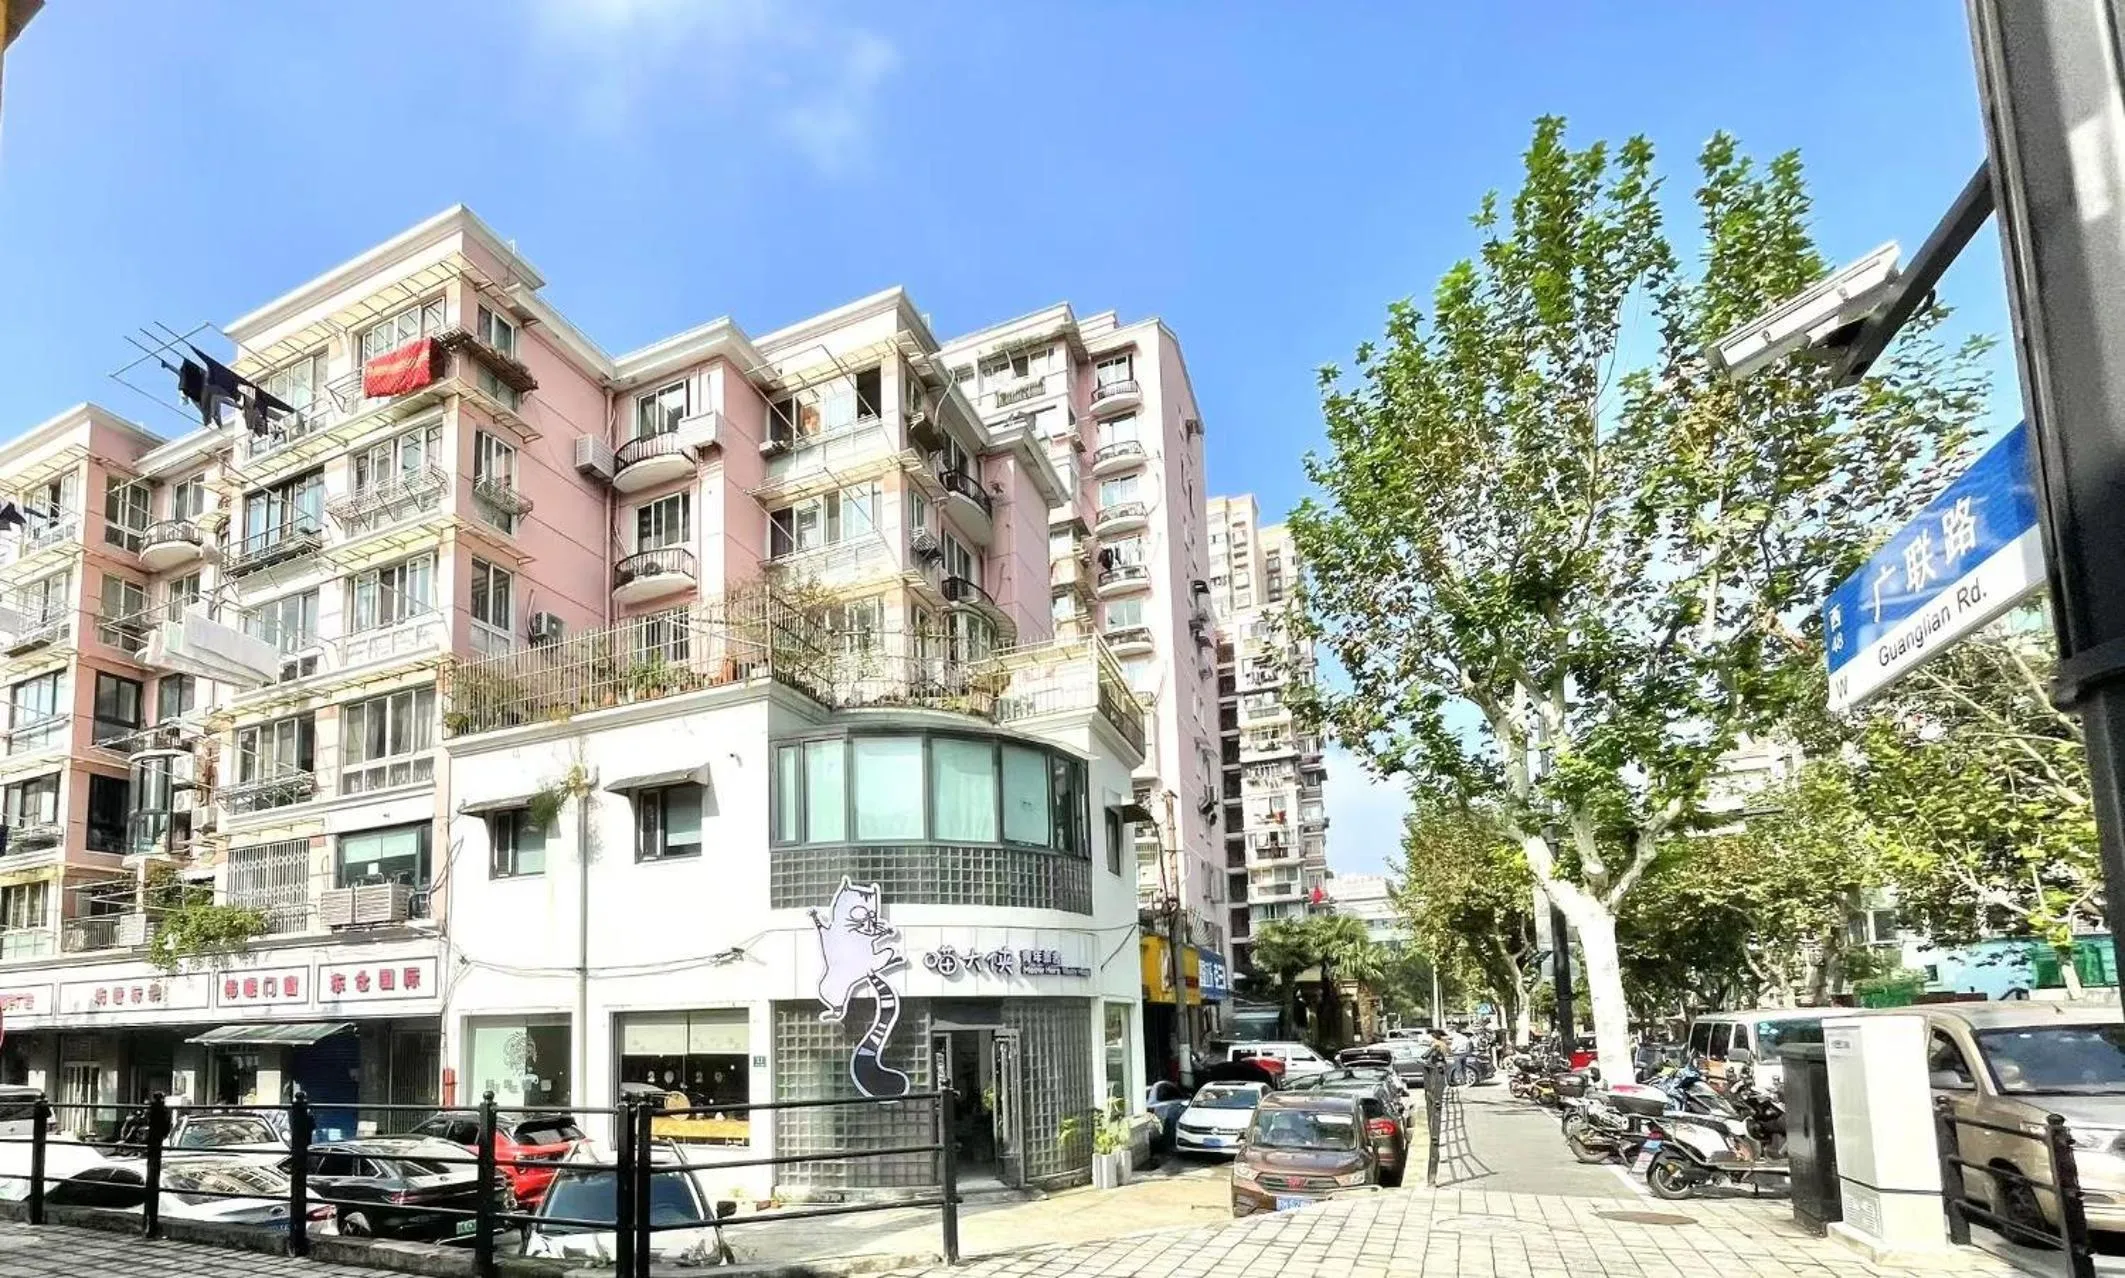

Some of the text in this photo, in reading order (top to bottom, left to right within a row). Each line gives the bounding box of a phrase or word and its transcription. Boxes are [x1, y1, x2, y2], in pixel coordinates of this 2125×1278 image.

[1873, 496, 1977, 623] 广联路
[1828, 603, 1842, 632] 西
[1878, 577, 1987, 667] Guanglian Rd.
[1835, 676, 1848, 698] W
[923, 945, 1024, 976] 喵大侠
